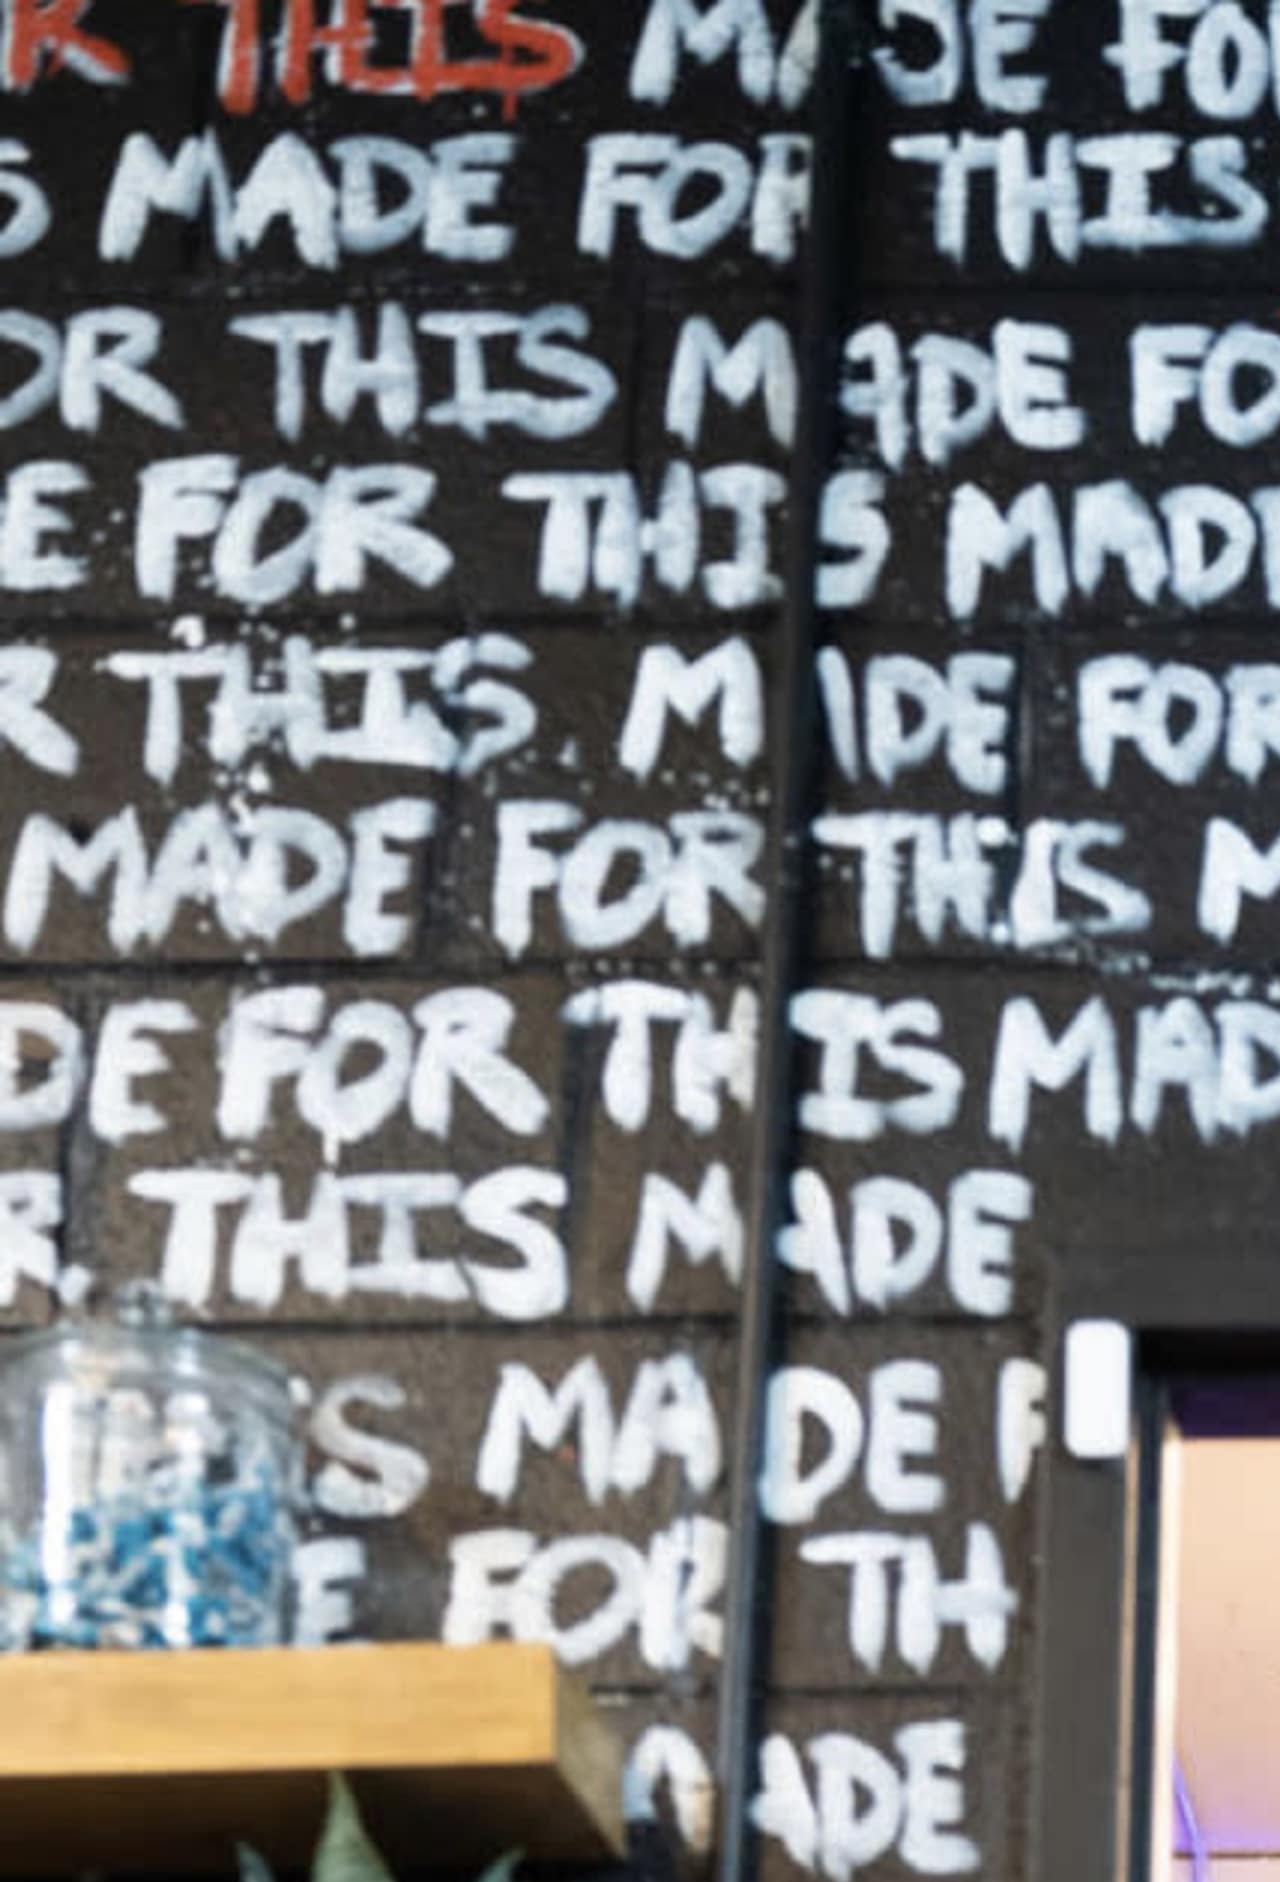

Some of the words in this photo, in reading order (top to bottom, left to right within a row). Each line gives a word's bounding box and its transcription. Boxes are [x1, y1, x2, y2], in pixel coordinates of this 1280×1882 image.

[100, 133, 512, 267] MADE
[891, 129, 1267, 268] THIS
[231, 304, 616, 437] THIS
[666, 319, 1083, 467] MADE
[135, 455, 452, 602] FOR
[502, 462, 890, 608] THIS
[96, 632, 536, 784] THIS
[3, 794, 432, 955] MADE
[493, 796, 764, 956] FOR
[813, 813, 1150, 957] THIS
[216, 987, 548, 1150] FOR
[565, 980, 963, 1139] THIS
[128, 1167, 566, 1318] THIS
[475, 1355, 947, 1525] MADE
[443, 1518, 725, 1665] FOR
